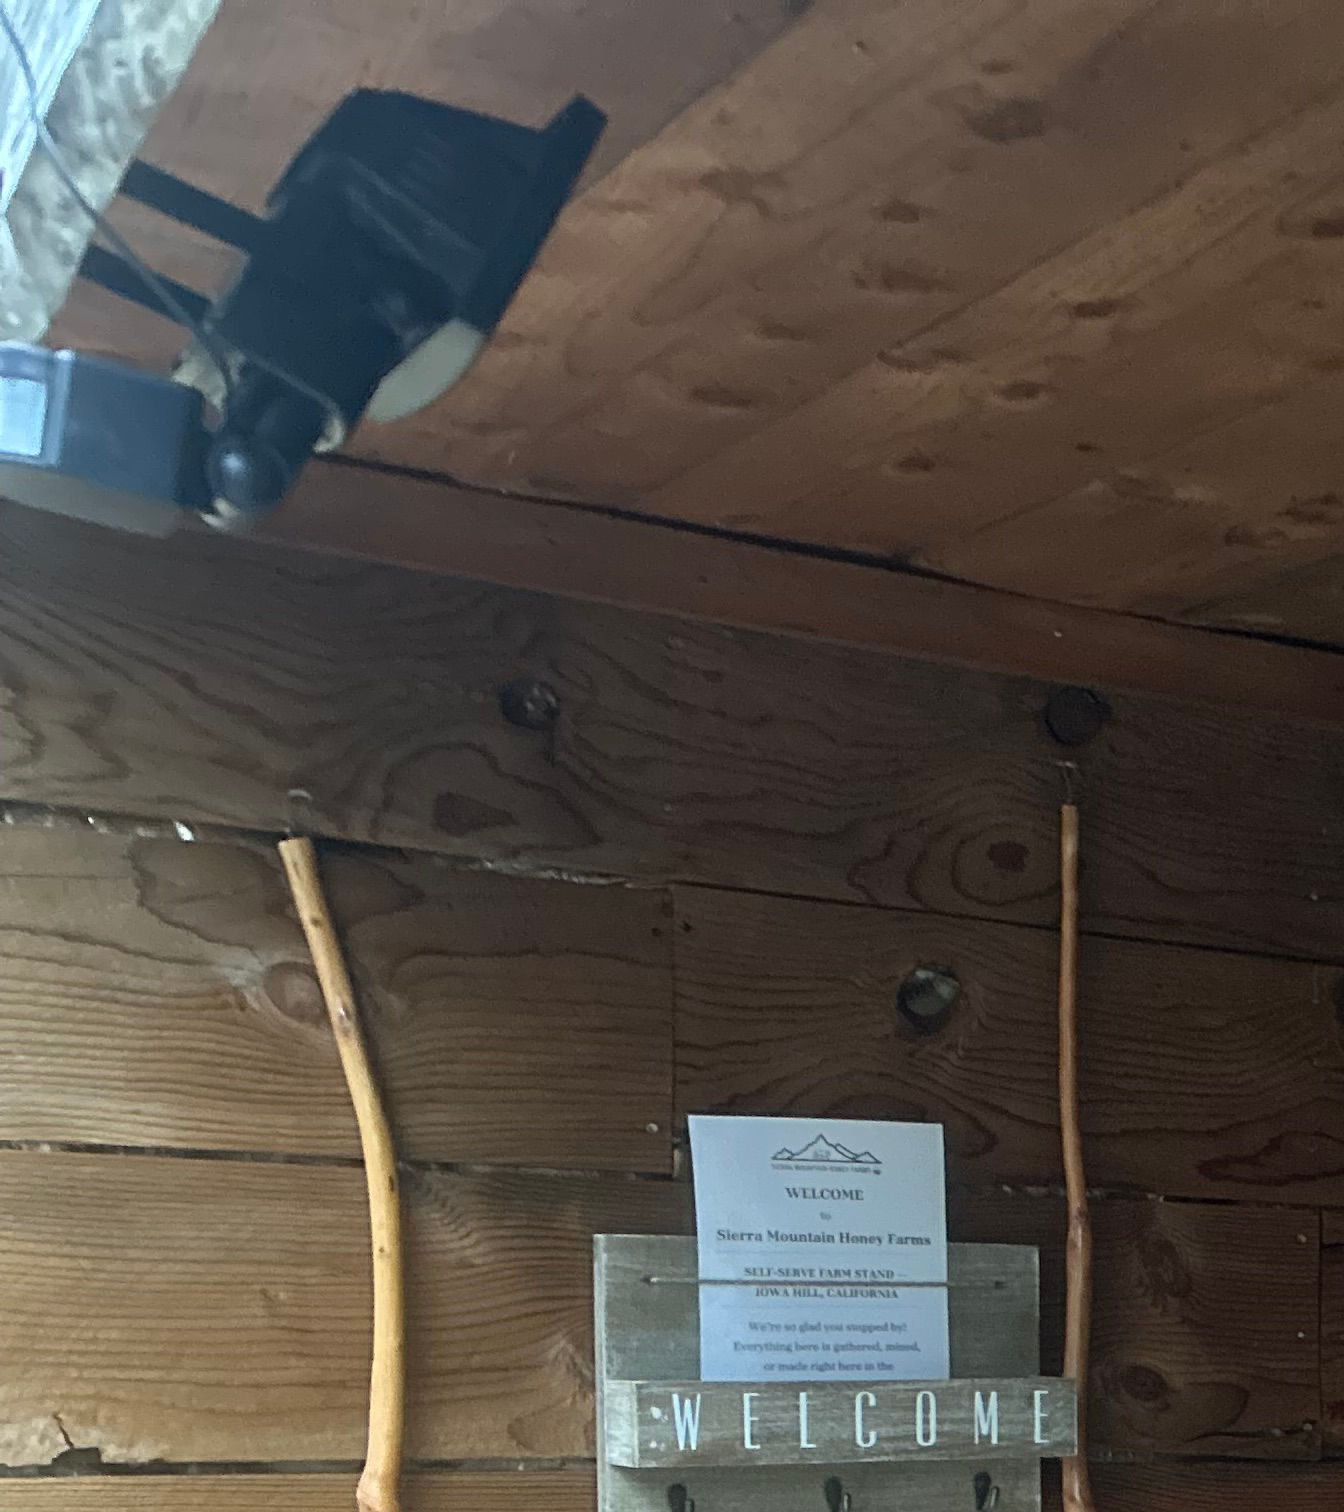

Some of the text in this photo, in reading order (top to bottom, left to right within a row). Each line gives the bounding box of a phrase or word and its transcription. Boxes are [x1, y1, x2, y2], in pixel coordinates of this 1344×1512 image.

[785, 1186, 864, 1202] WELCOME
[819, 1211, 832, 1221] to
[716, 1229, 932, 1247] Sierra Mountain Honey Farms
[744, 1266, 895, 1280] SELF-SERVE FARM STAND
[755, 1287, 789, 1298] IOWA
[826, 1288, 899, 1300] CALIFORNIA
[798, 1321, 822, 1335] glad
[823, 1324, 844, 1336] you
[732, 1341, 793, 1354] Everything
[794, 1341, 820, 1352] here
[763, 1363, 775, 1371] or
[778, 1361, 808, 1372] made
[810, 1361, 837, 1374] right
[838, 1361, 864, 1372] here
[877, 1361, 895, 1372] the
[672, 1390, 1050, 1451] WELCOME
